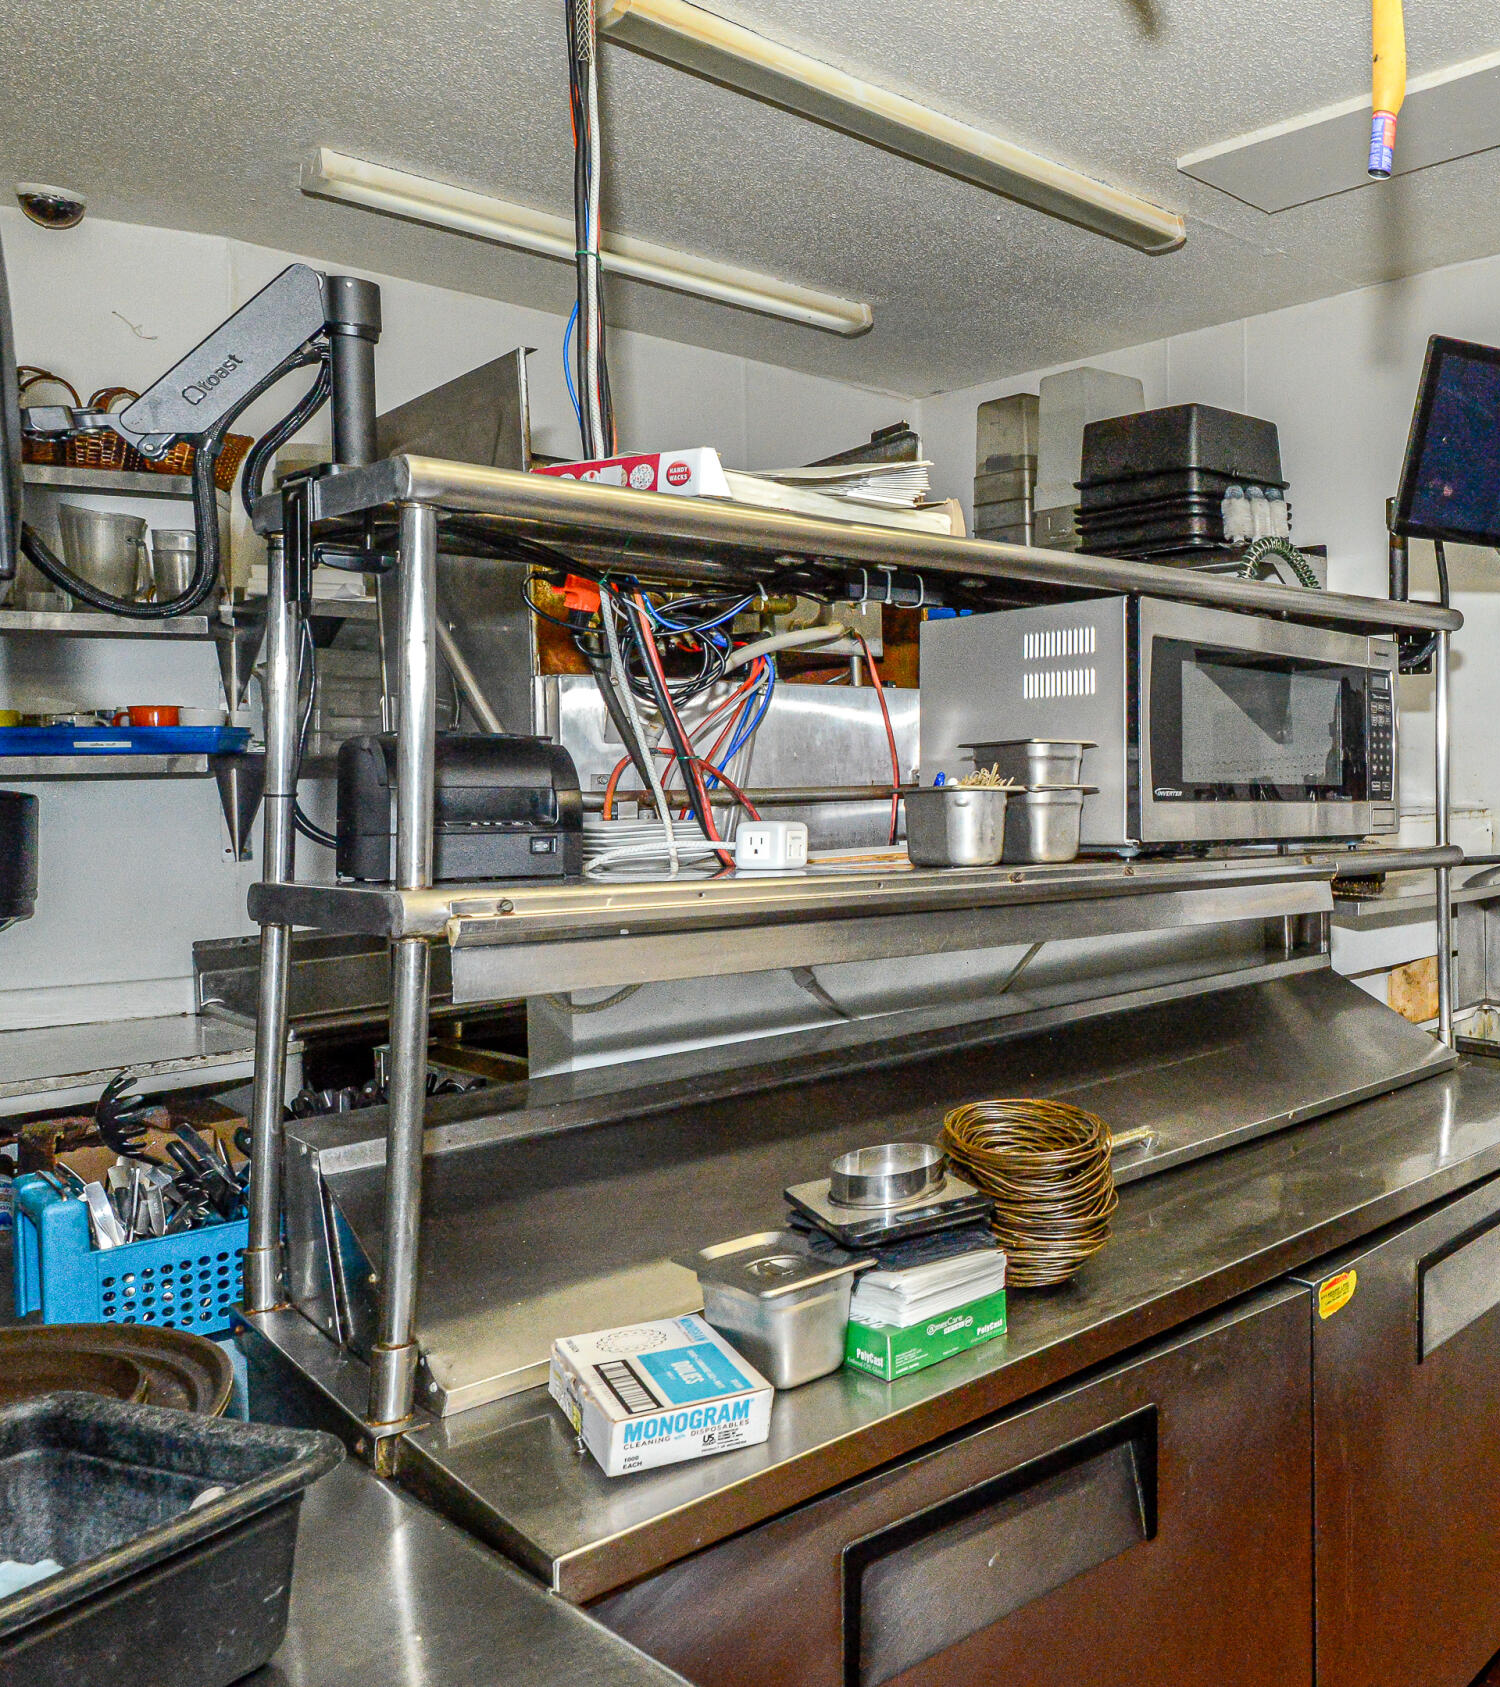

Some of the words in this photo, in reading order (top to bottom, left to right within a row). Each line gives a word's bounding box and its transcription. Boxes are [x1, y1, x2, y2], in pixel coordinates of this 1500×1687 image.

[198, 354, 243, 391] toast
[977, 1318, 1003, 1336] PolyCast
[856, 1348, 884, 1368] PolyCast
[624, 1399, 750, 1443] MONOGRAM
[623, 1435, 671, 1450] CLEANING
[690, 1418, 750, 1437] DISPOSABLES
[702, 1433, 715, 1443] US
[622, 1461, 643, 1470] EACH
